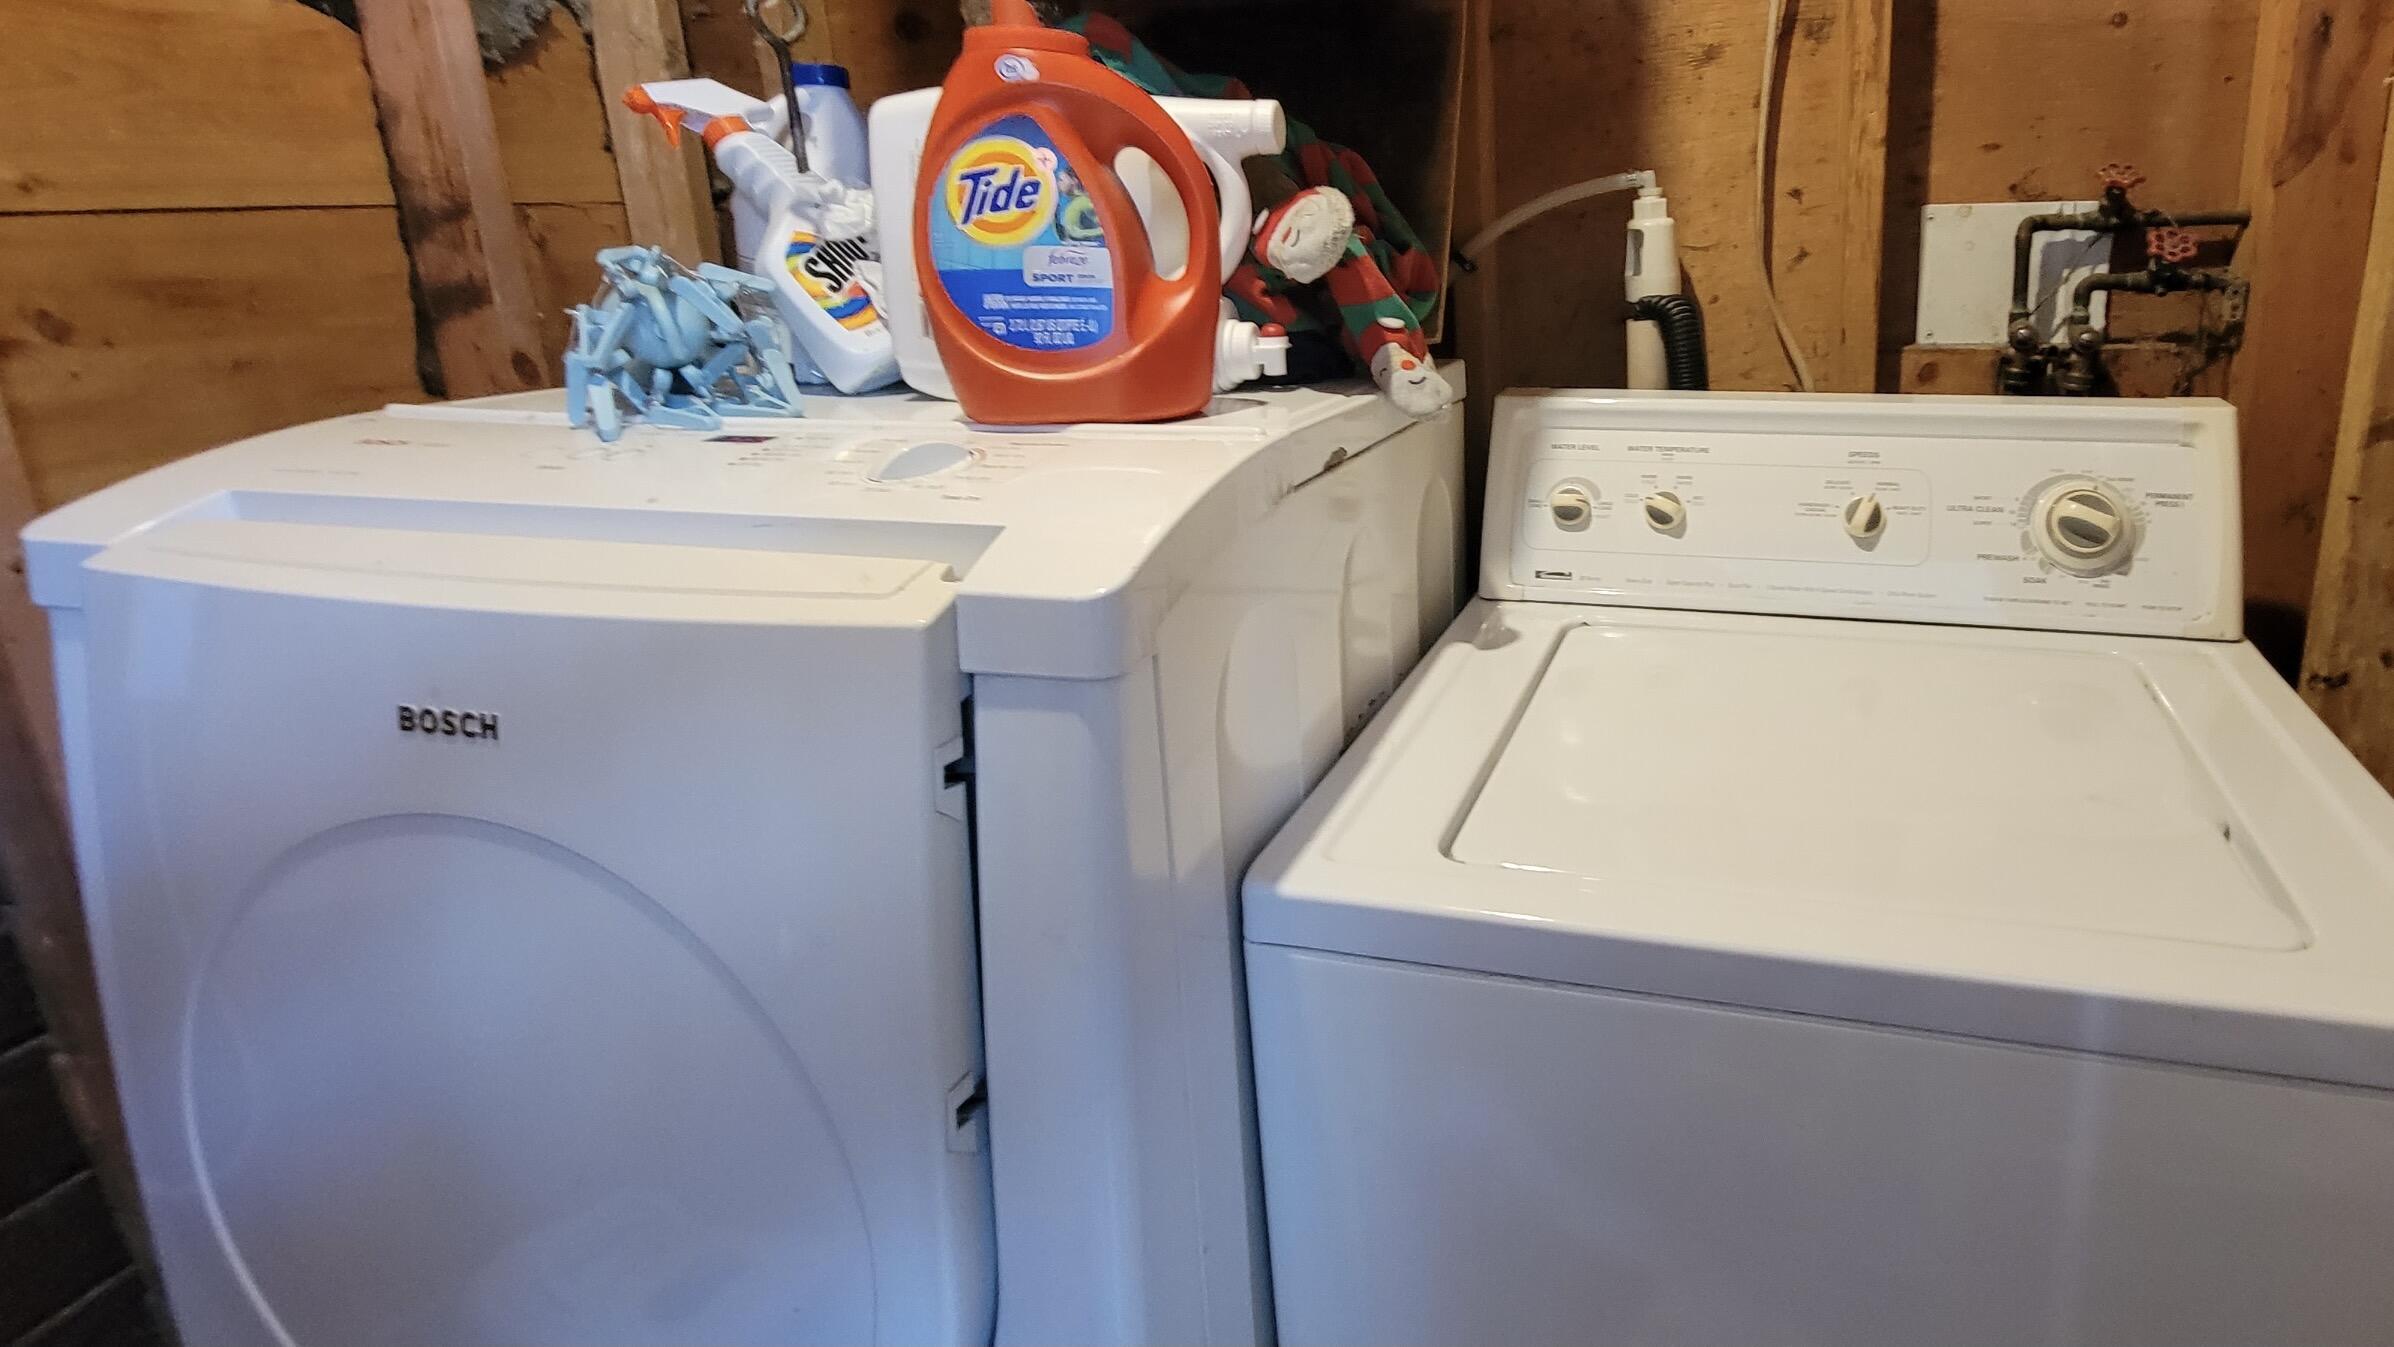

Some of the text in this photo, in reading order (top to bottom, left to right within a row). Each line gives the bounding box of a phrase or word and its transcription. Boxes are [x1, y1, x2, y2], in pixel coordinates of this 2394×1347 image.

[959, 167, 1042, 226] Tide
[1032, 273, 1074, 283] SPORT
[1551, 443, 1577, 451] WATER
[1655, 446, 1710, 454] TEMPERATURE
[1946, 504, 2004, 513] ULTRA CLEAN
[2023, 576, 2047, 584] SOAK
[398, 705, 498, 740] BOSCH
